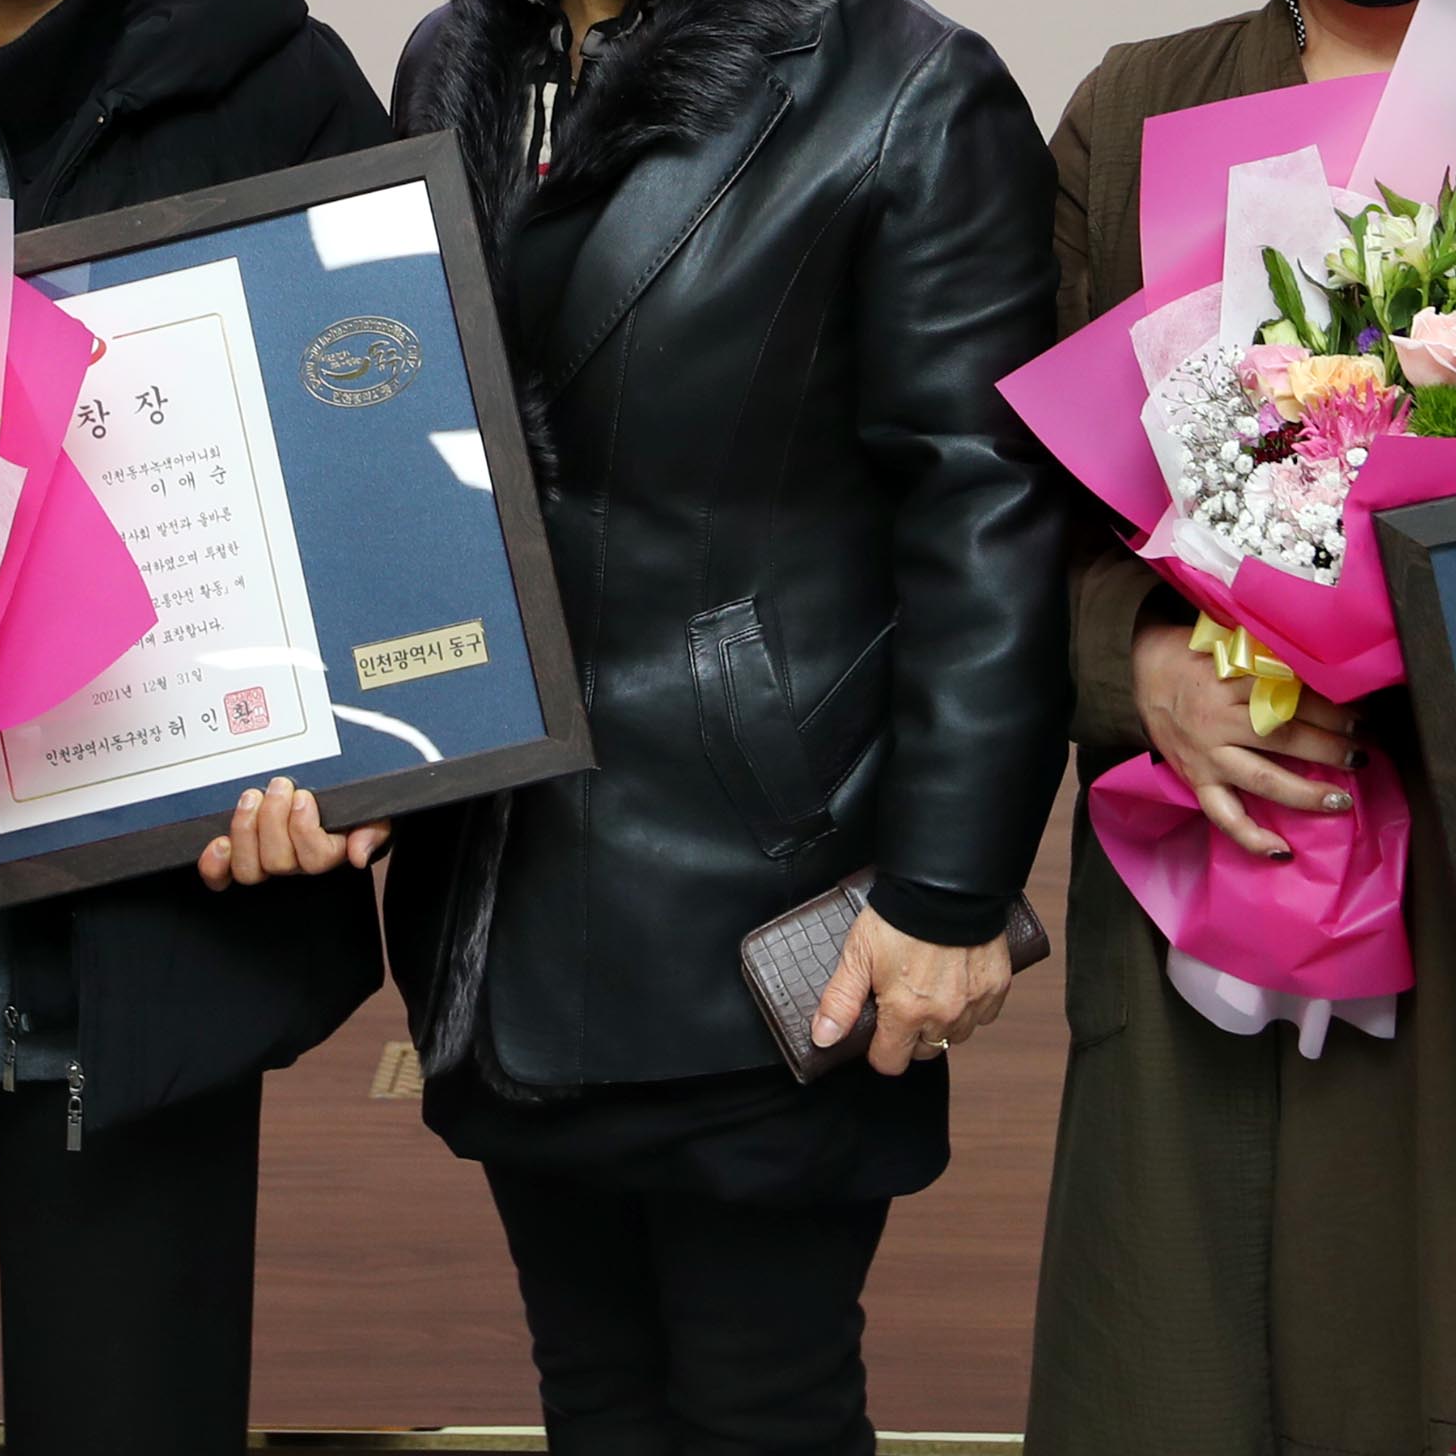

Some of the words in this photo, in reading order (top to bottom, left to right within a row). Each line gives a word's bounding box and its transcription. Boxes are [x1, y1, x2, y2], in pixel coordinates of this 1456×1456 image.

[77, 399, 111, 439] 창
[135, 385, 169, 425] 장
[102, 445, 222, 486] 인천동부녹색어머니회
[359, 641, 444, 678] 인천광역시
[449, 633, 482, 658] 동구
[92, 684, 133, 706] 2021년
[142, 676, 168, 694] 12월
[176, 668, 203, 686] 31일
[45, 725, 163, 767] 인천광역시동구청장
[200, 708, 219, 732] 인
